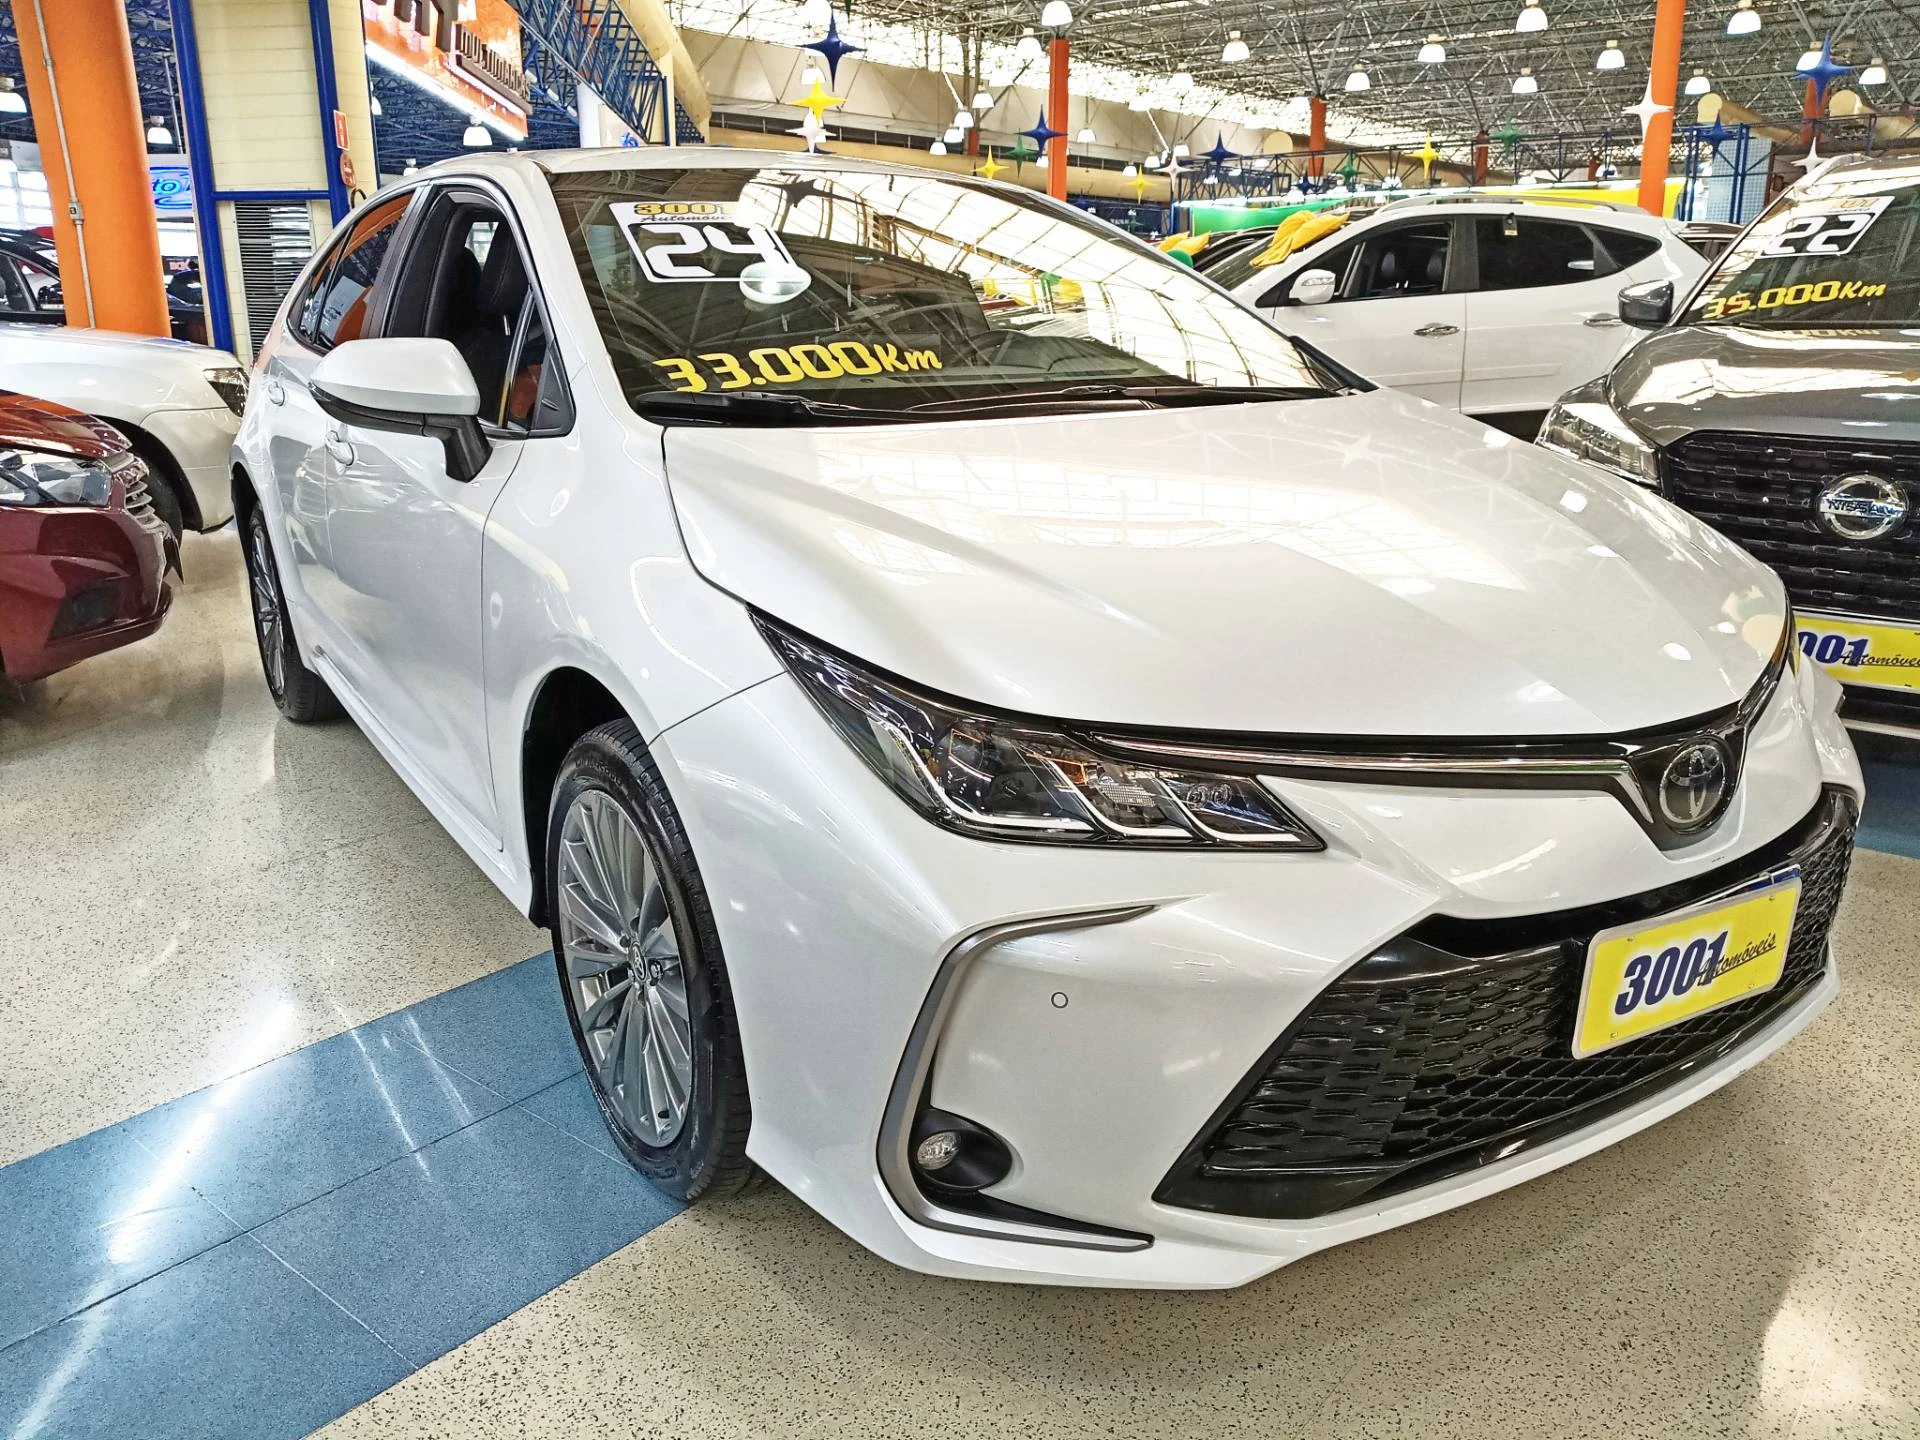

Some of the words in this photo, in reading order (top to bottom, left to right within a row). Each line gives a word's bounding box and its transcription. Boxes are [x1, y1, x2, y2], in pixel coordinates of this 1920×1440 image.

[640, 224, 788, 278] 24
[1763, 213, 1873, 255] 22
[1702, 281, 1887, 318] 35.000Km
[652, 341, 943, 392] 33.000Km
[1827, 498, 1898, 516] NISSAN
[1797, 631, 1868, 667] 001
[1615, 931, 1728, 1015] 3001
